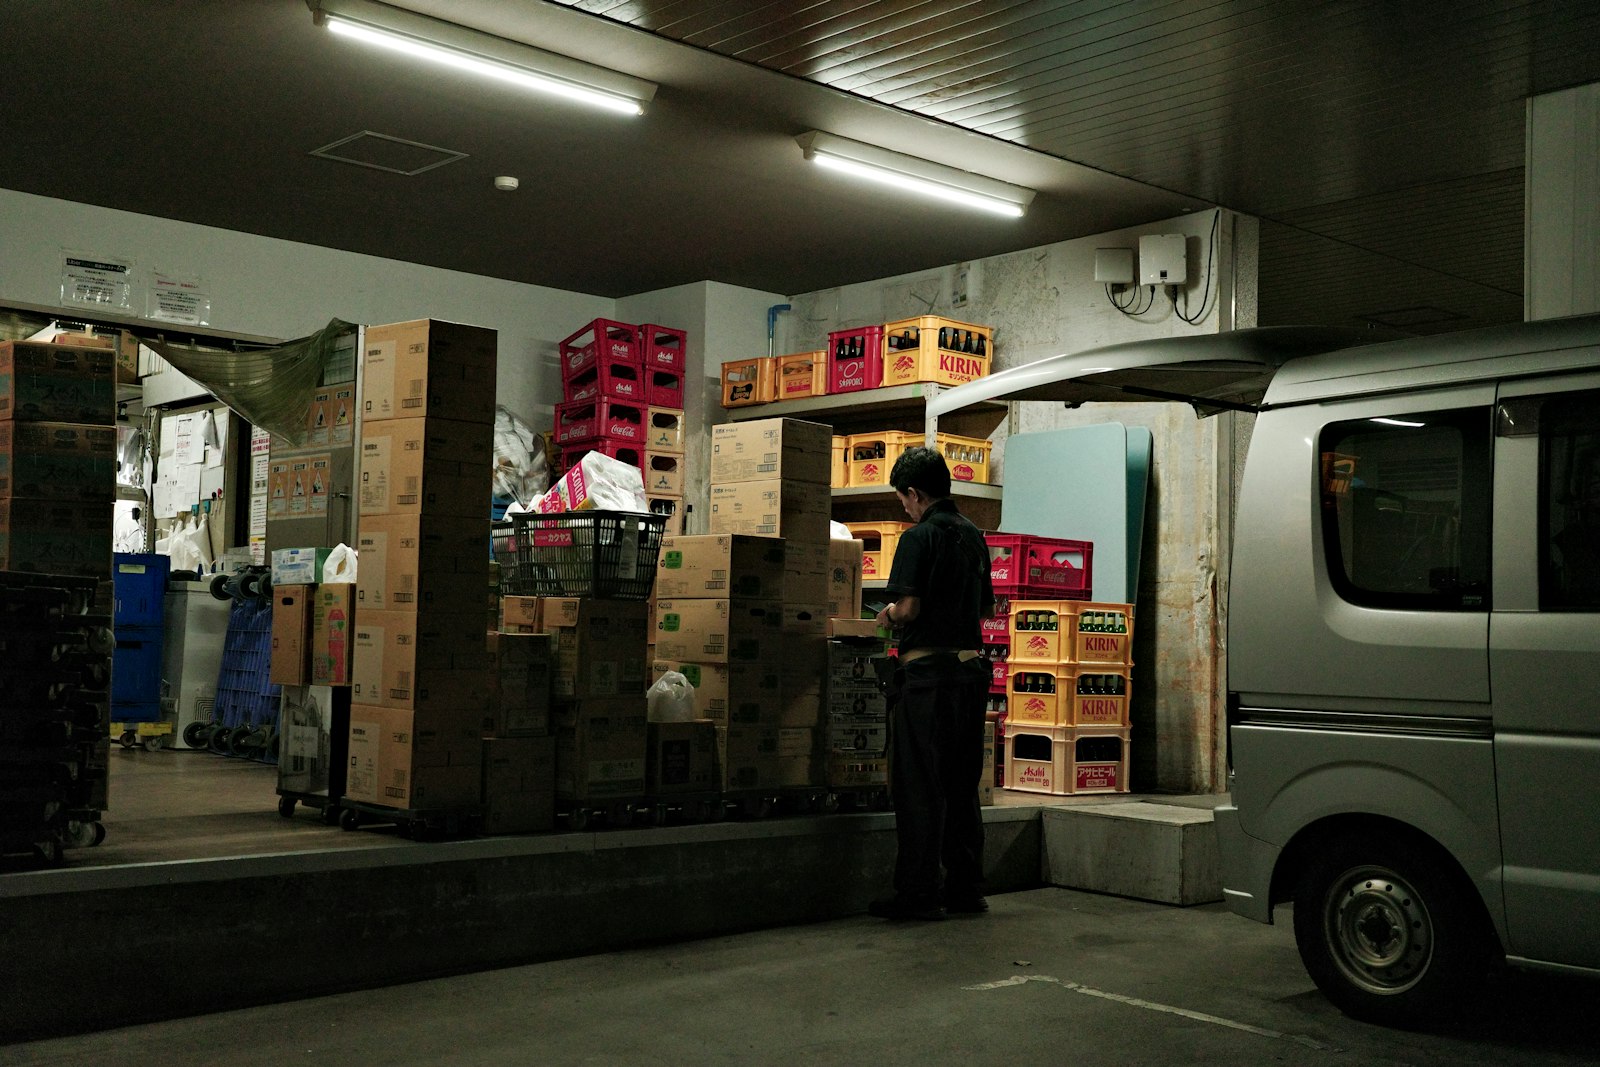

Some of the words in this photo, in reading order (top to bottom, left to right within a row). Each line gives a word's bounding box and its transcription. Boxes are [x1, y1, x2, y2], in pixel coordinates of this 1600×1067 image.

[612, 344, 628, 353] Asahi
[657, 351, 674, 360] Asahi
[939, 354, 982, 376] KIRIN
[616, 383, 632, 392] Asahi
[611, 424, 635, 437] Coca-Cola
[548, 533, 571, 542] カクヤス
[983, 619, 1006, 631] Coca-Cola
[1086, 637, 1118, 651] KIRIN
[1082, 700, 1118, 714] KIRIN
[1024, 766, 1045, 777] Asahi
[1077, 767, 1116, 778] アサヒビール
[1042, 779, 1050, 787] 20
